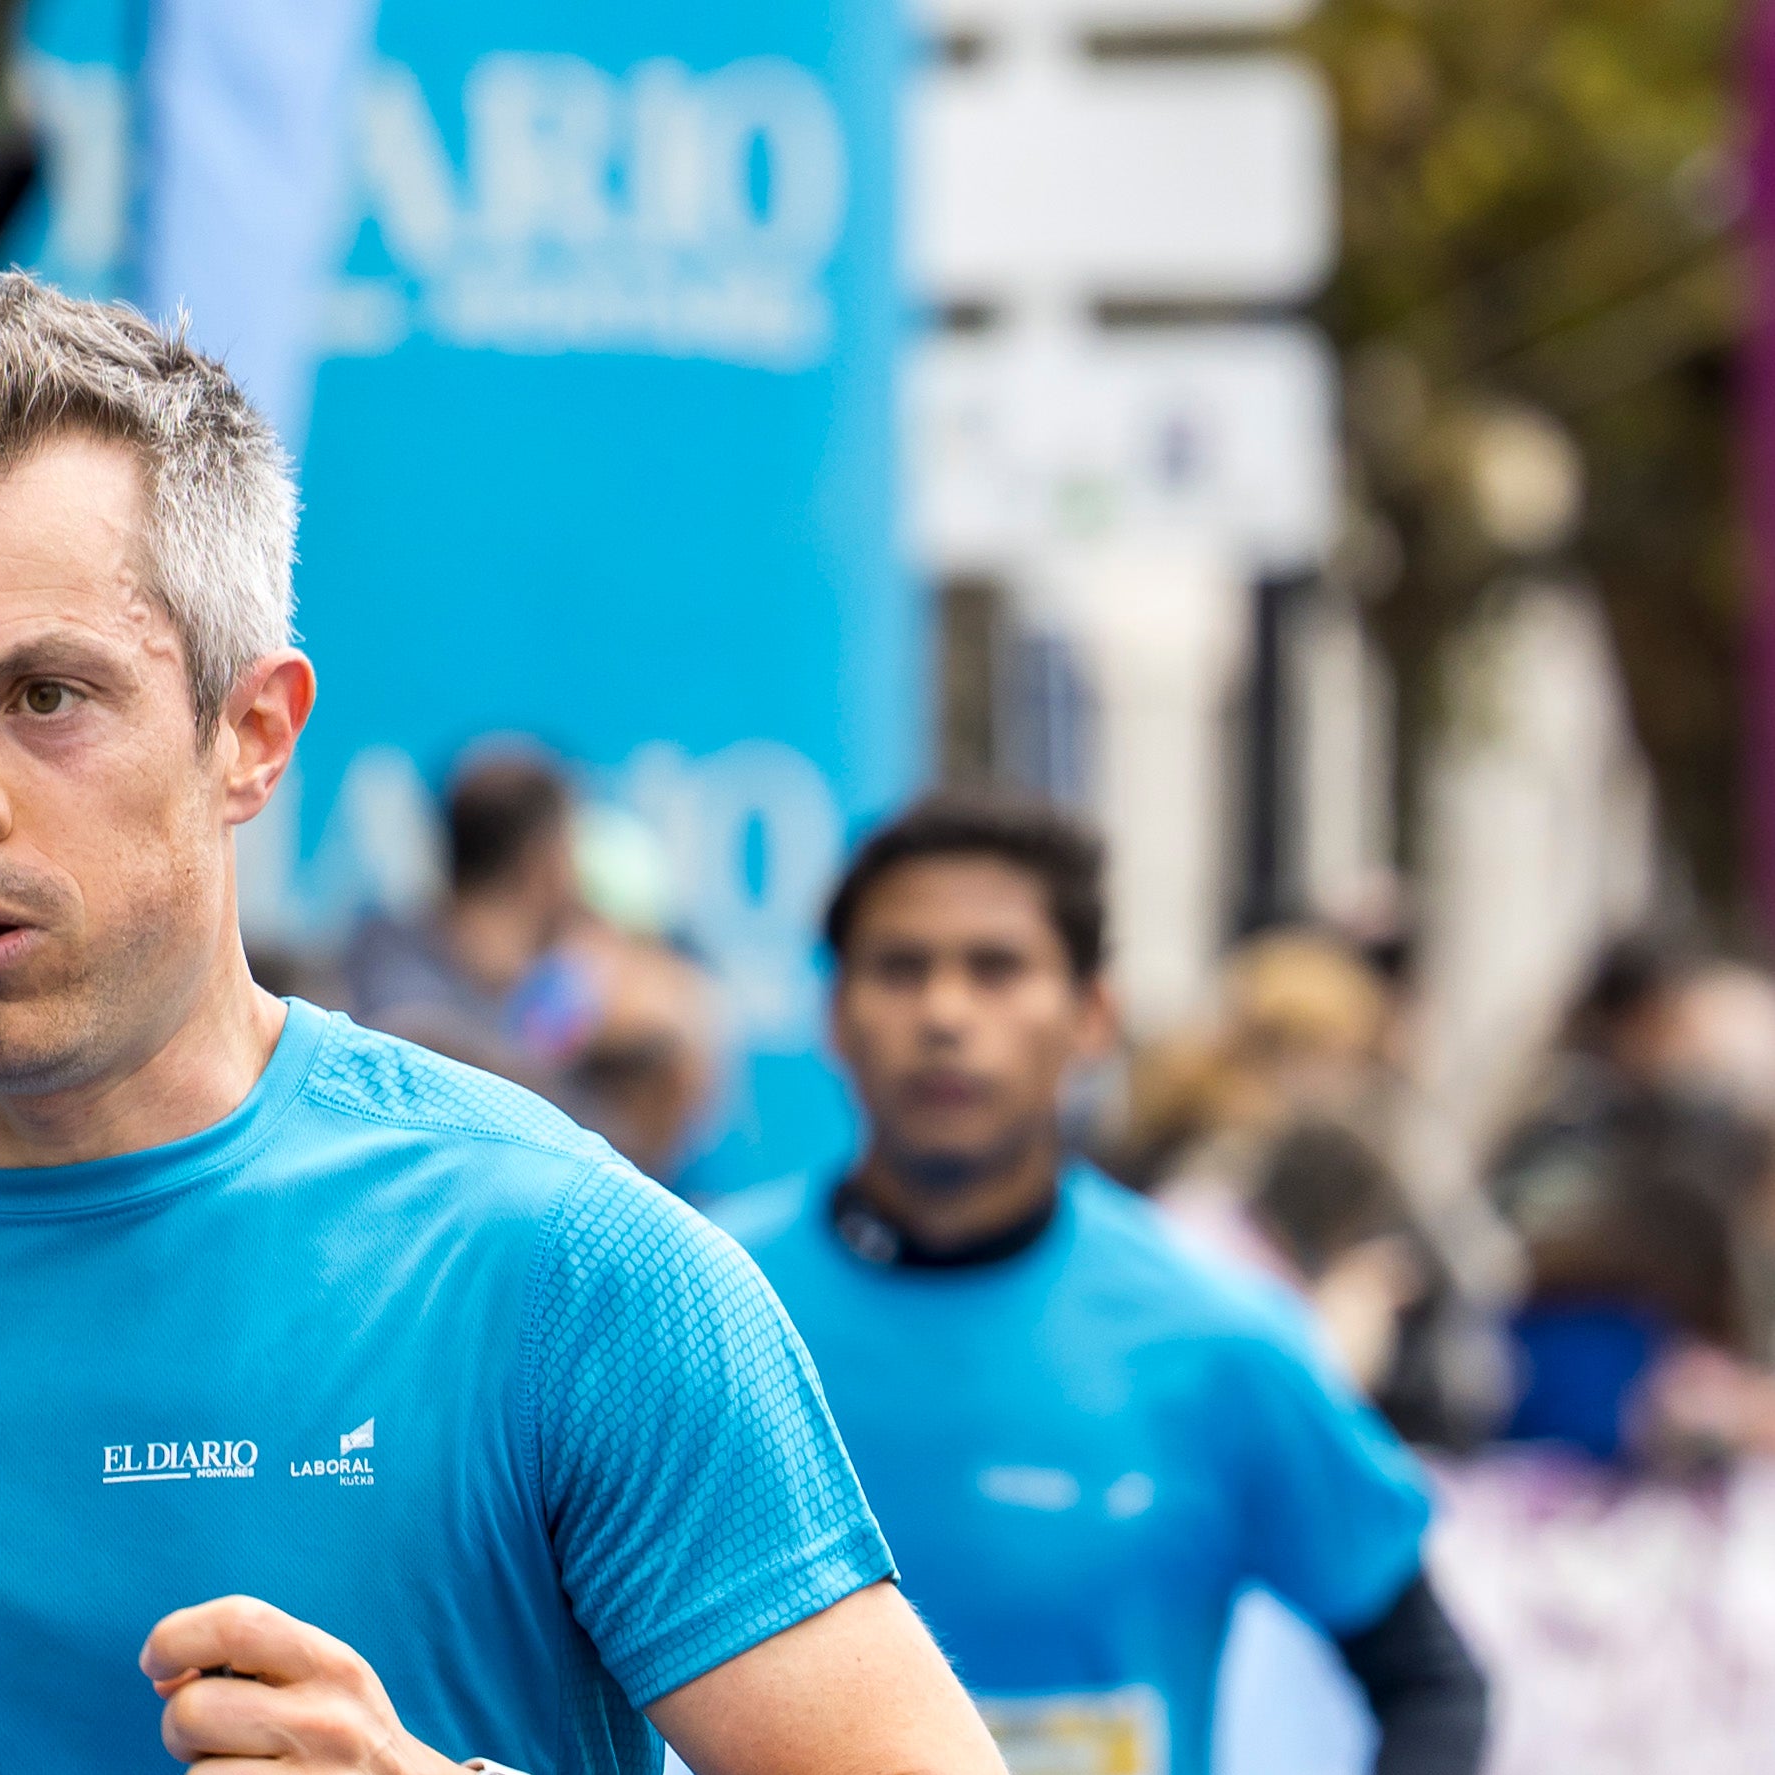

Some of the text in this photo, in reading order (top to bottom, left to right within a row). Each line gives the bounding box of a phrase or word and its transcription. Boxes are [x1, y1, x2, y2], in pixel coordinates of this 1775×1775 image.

[103, 1440, 258, 1473] EL DIARIO
[290, 1458, 374, 1477] LABORAL
